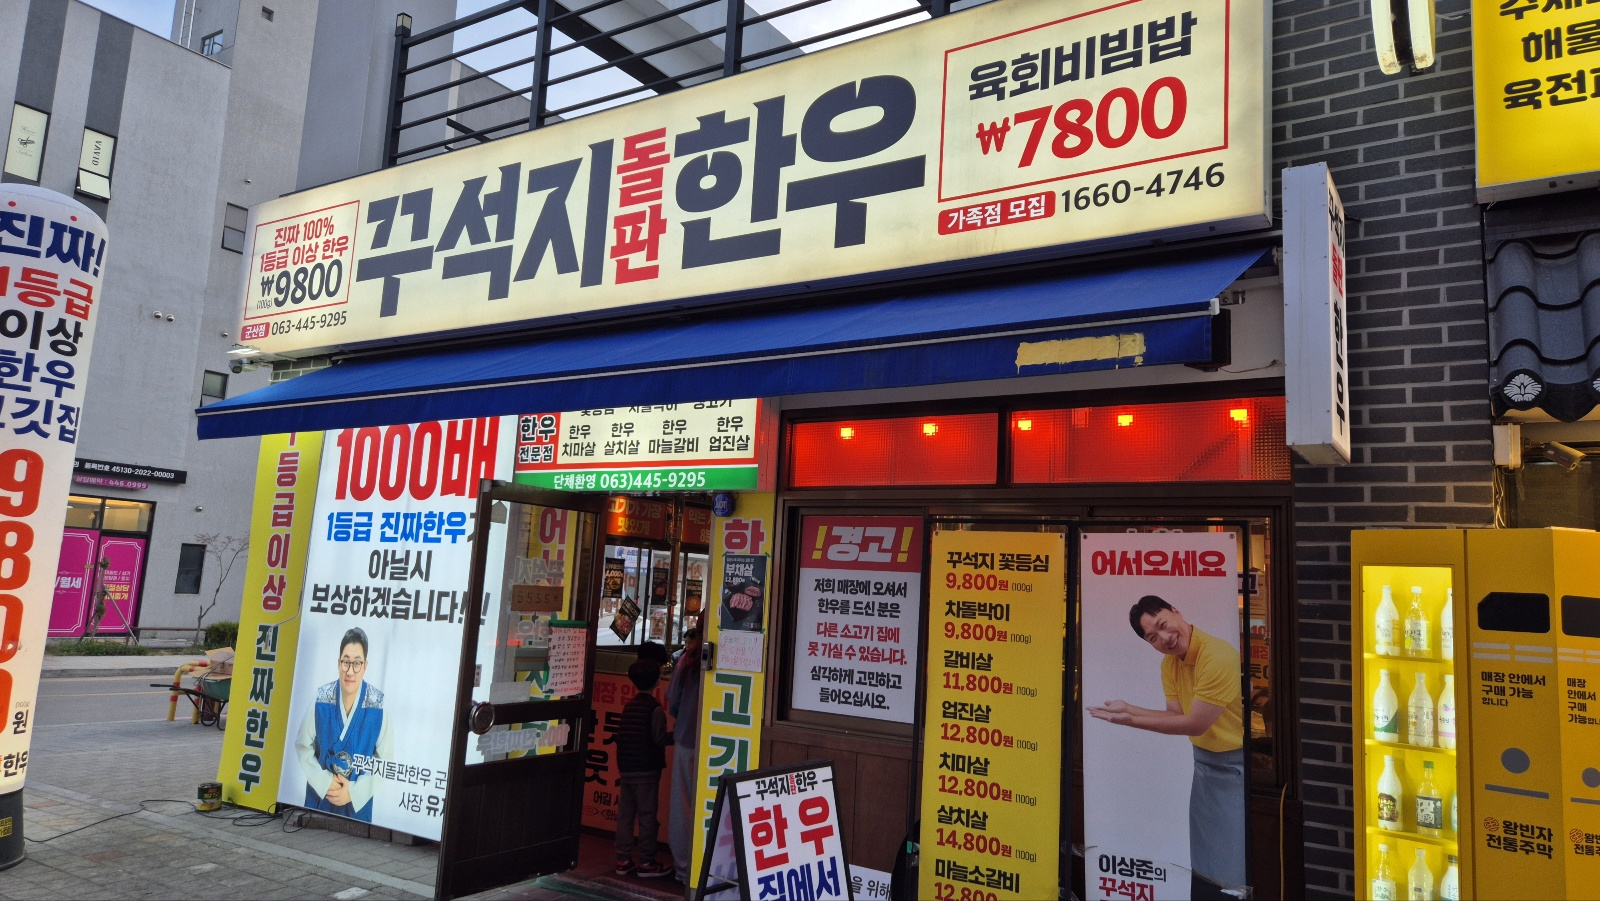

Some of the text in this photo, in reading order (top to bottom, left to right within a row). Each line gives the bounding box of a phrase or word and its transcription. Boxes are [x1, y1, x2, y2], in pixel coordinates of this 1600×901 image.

[969, 10, 1198, 101] 육회비빔밥
[356, 74, 927, 318] 꾸석지 돌판 한우
[1061, 162, 1225, 213] 1660-4746
[947, 194, 1046, 231] 가족점 모집
[274, 215, 334, 249] 진짜 100%
[260, 235, 349, 273] 1등급 이상 한우
[0, 309, 83, 357] 이상
[271, 310, 347, 336] 063-445-9295
[0, 348, 75, 399] 한우
[520, 415, 557, 443] 한우
[569, 415, 744, 440] 한우 한우 한우 한우
[518, 444, 554, 464] 전문점
[561, 434, 751, 458] 치마살 살치살 마늘갈비 업진살
[111, 465, 175, 479] 45130-2022-00003
[553, 471, 706, 490] 단체환영 063)445-9295
[327, 511, 373, 543] 1등급
[368, 549, 433, 583] 아닐시
[724, 563, 755, 578] 부채살
[946, 551, 1050, 573] 꾸석지 꽃등심
[1091, 550, 1227, 577] 어서오세요
[814, 578, 908, 599] 저희 매장에 오셔서
[945, 572, 1033, 593] 9,800원 (100g)
[818, 598, 902, 619] 한우를 드신 분은
[944, 599, 1010, 622] 차돌박이
[816, 621, 900, 644] 다른 소고기 집에
[944, 621, 1032, 645] 9,800원 (100g)
[807, 641, 908, 666] 못 가실 수 있습니다.
[943, 650, 993, 672] 갈비살
[810, 665, 903, 690] 심각하게 고민하고
[942, 671, 1038, 698] 11,800원 (100g)
[1481, 671, 1546, 687] 매장 안에서
[1566, 677, 1586, 688] 매장
[819, 687, 890, 711] 들어오십시오.
[1481, 684, 1534, 699] 구매 가능
[1567, 689, 1597, 702] 안에서
[941, 700, 992, 724] 업진살
[1567, 701, 1587, 713] 구매
[940, 722, 1038, 752] 12,800원 (100g)
[352, 754, 431, 787] 꾸석지돌판한우
[938, 751, 991, 777] 치마살
[755, 774, 790, 801] 꾸석지
[795, 770, 819, 793] 한우
[938, 774, 1037, 807] 12,800원 (100g)
[398, 791, 423, 813] 사장
[937, 804, 989, 831] 살치살
[1502, 820, 1553, 843] 왕빈자
[936, 827, 1037, 863] 14,800원 (100g)
[1486, 833, 1554, 860] 전통주막
[1098, 853, 1167, 882] 이상준의
